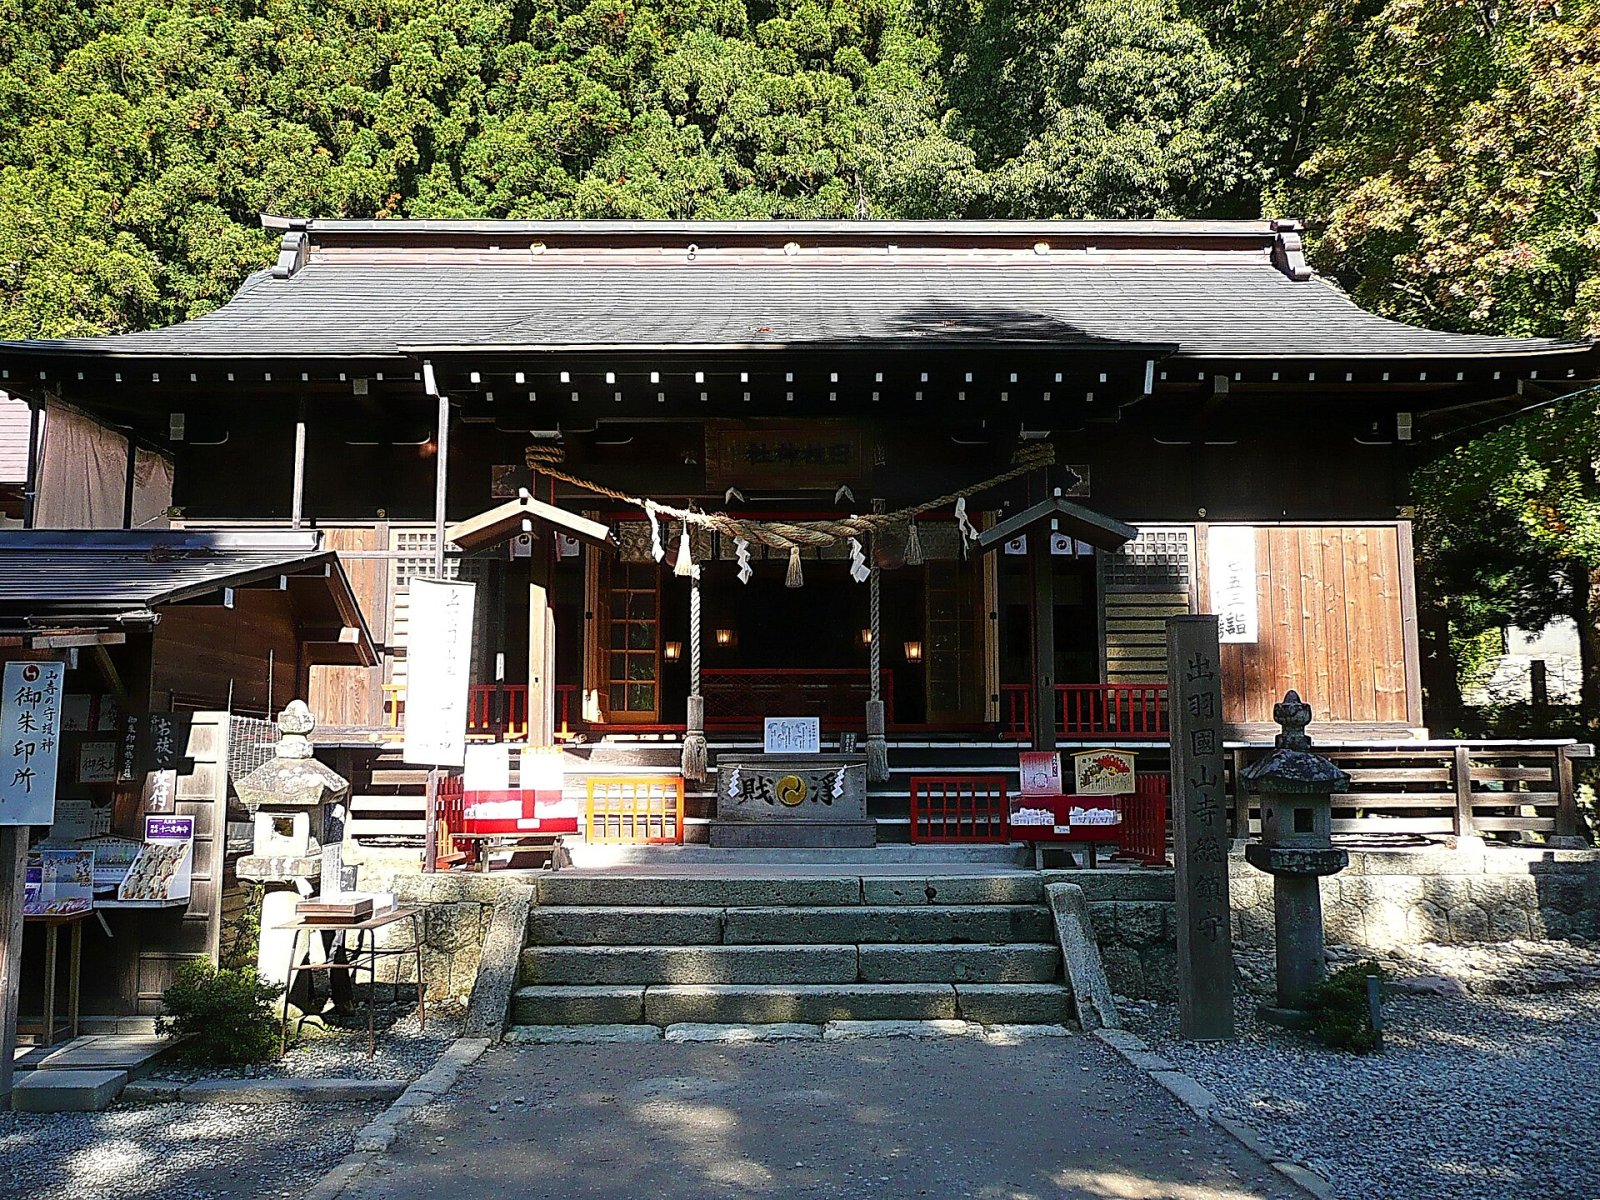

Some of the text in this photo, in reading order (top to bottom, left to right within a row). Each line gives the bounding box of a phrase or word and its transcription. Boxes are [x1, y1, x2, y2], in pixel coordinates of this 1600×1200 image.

[9, 686, 42, 794] 御朱印所
[40, 670, 59, 754] 山寺の守護神
